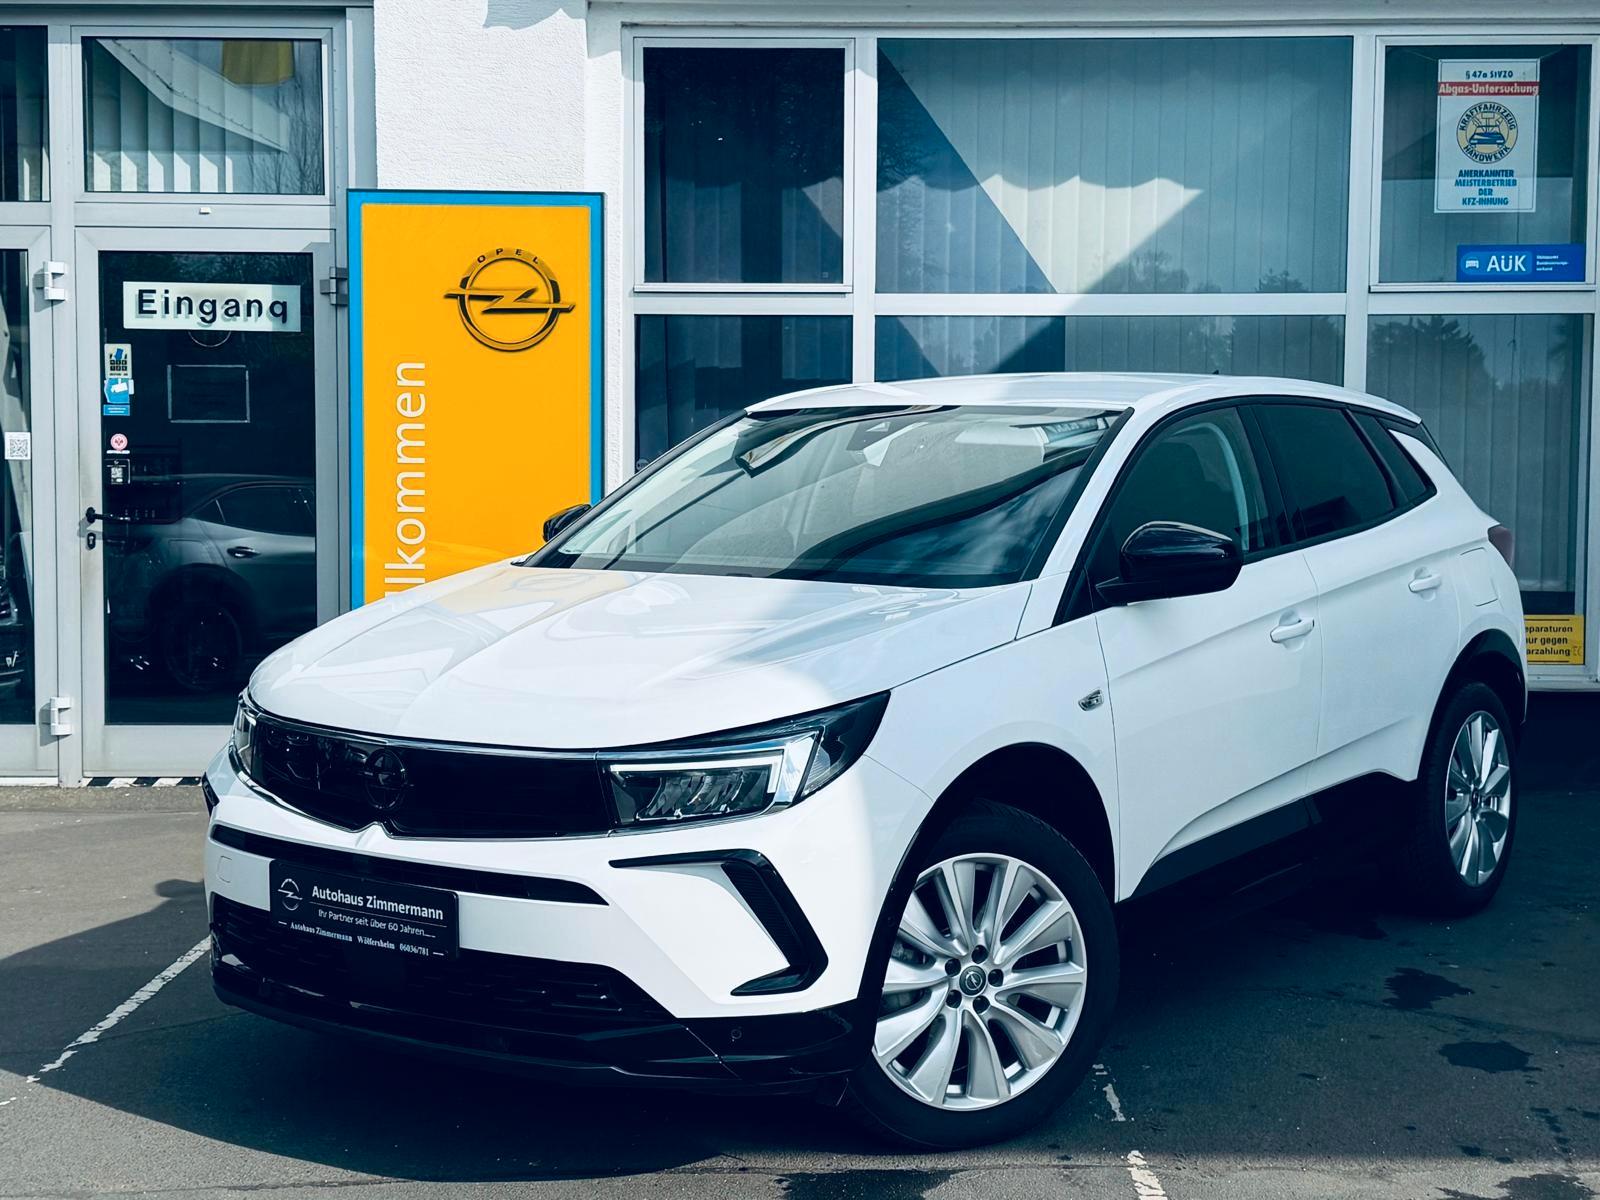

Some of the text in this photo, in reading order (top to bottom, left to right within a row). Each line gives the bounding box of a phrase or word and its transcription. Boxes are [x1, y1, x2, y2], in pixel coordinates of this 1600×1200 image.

[1472, 70, 1488, 78] 47a
[1439, 83, 1539, 96] Abgas-Untersuchung
[1459, 103, 1517, 131] KRAFTFAHRZEUG
[1463, 144, 1510, 161] HANDWERK
[1458, 169, 1515, 178] ANERKANNTER
[1454, 178, 1518, 187] MEISTERBETRIEB
[1478, 188, 1493, 196] DER
[1462, 197, 1509, 206] KFZ-INNUNG
[477, 248, 539, 264] OPEL
[1487, 254, 1526, 272] AÜK
[1525, 625, 1573, 633] eparaturen
[1540, 636, 1568, 646] gegen
[1526, 647, 1571, 656] arzahlung
[312, 885, 444, 921] Autohaus Zimmermann
[318, 908, 328, 918] Ihr
[328, 911, 354, 924] Partner
[354, 917, 369, 927] seit
[369, 918, 387, 930] über
[387, 922, 399, 932] 60
[290, 921, 430, 956] Autohaus Zimmermann Wölfersheim 06036/781
